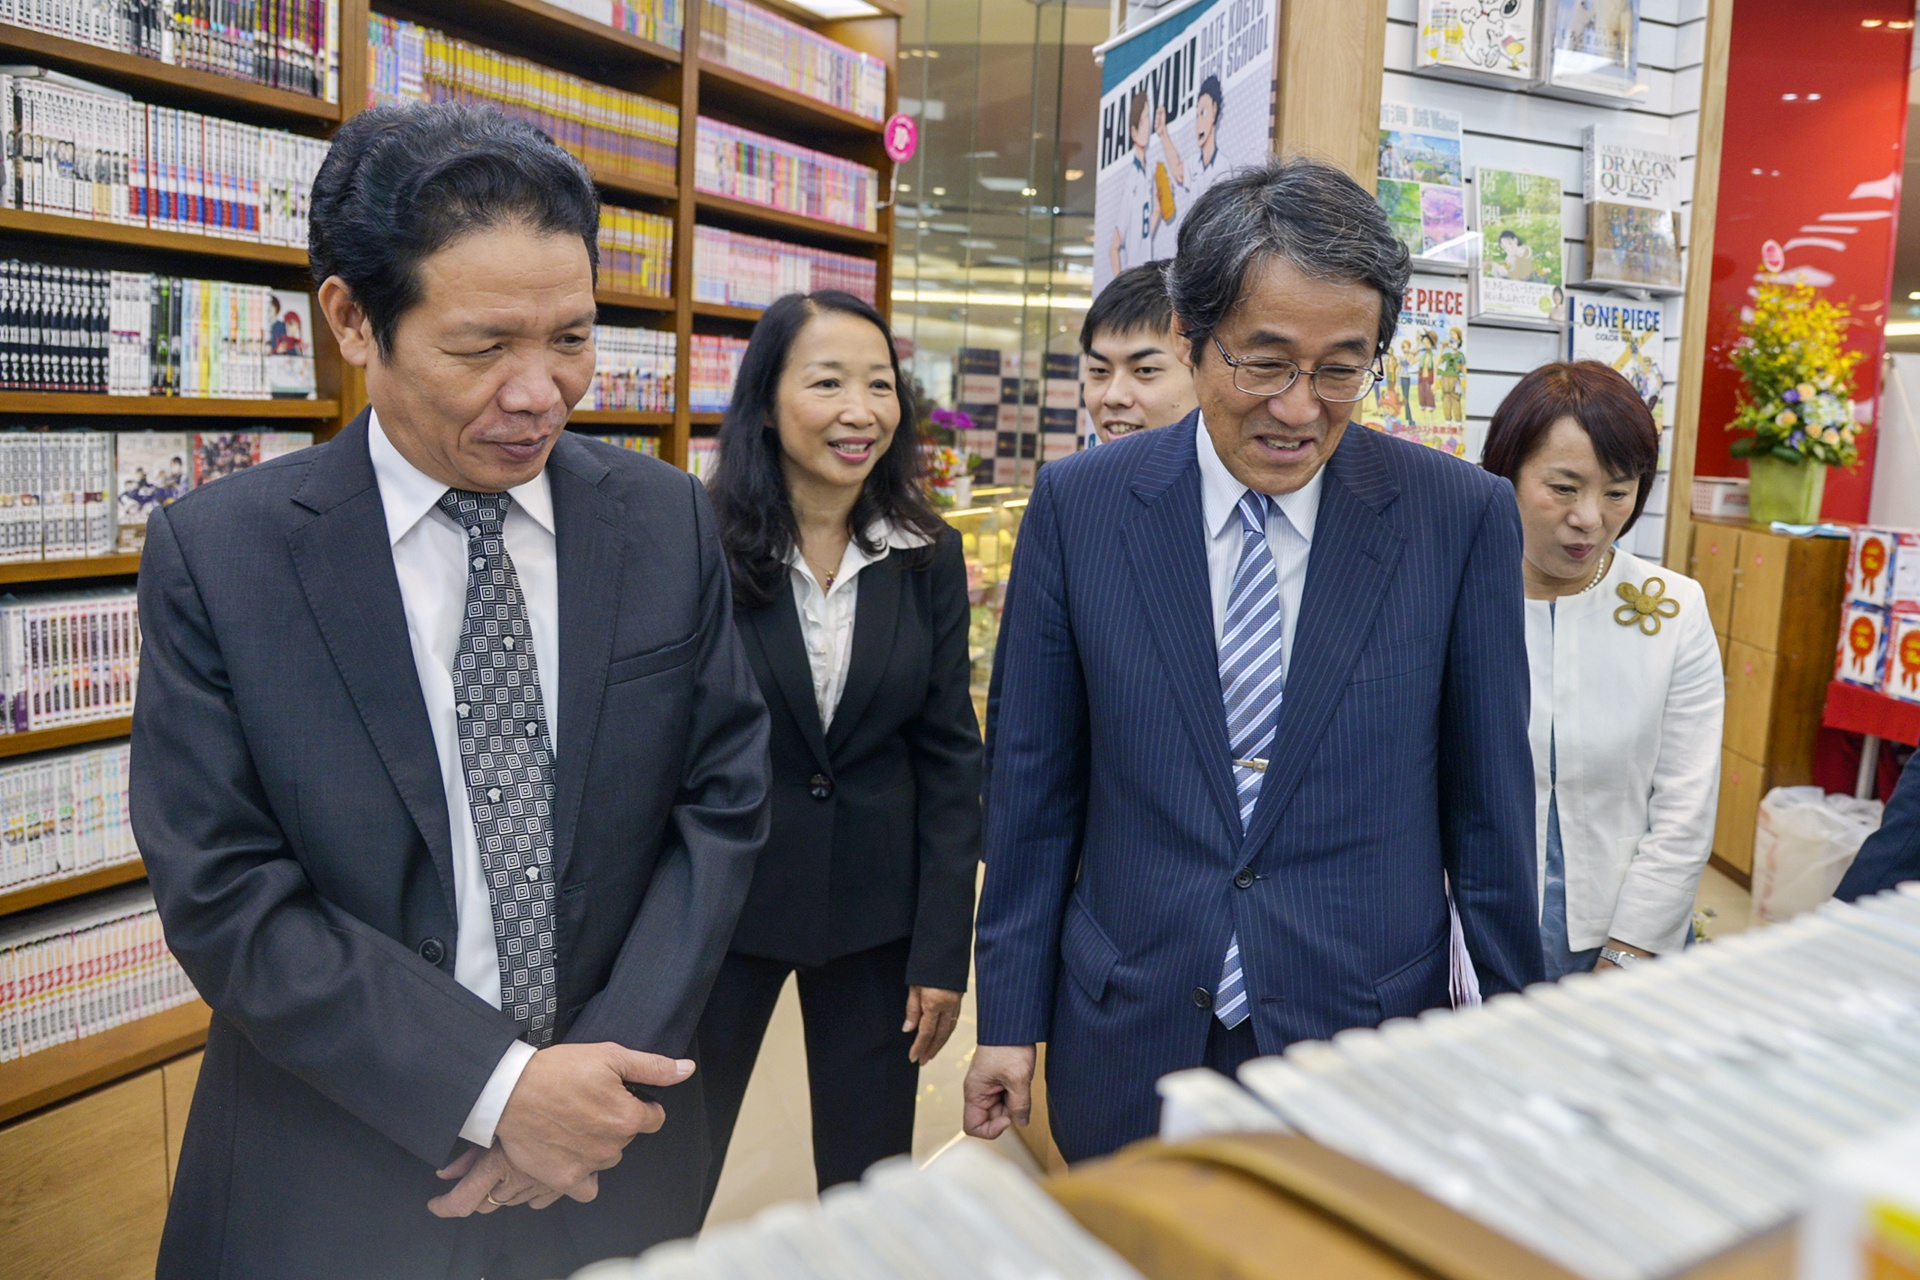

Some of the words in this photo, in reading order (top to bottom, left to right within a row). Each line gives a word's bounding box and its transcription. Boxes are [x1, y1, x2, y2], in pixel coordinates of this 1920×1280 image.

[1200, 11, 1225, 62] DATE
[1226, 13, 1268, 78] SCHOOL
[1601, 154, 1676, 180] DRAGON
[1601, 172, 1663, 196] QUEST
[1416, 288, 1463, 315] PIECE
[1415, 317, 1437, 327] WALK
[1583, 303, 1619, 328] ONE
[1622, 308, 1660, 332] PIECE
